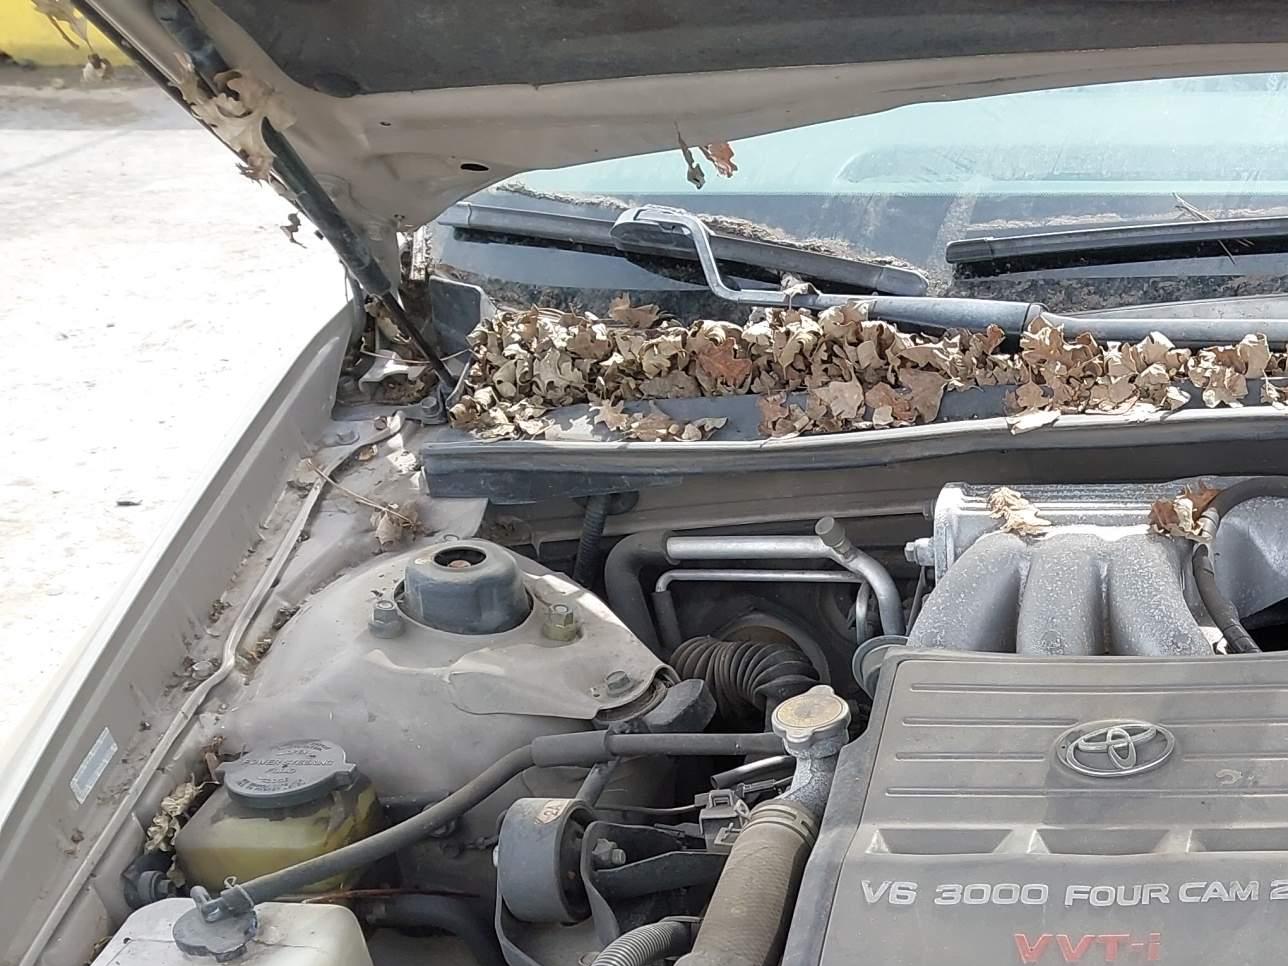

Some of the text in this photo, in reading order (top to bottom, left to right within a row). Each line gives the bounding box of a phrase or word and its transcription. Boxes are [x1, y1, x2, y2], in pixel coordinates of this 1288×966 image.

[861, 879, 918, 905] V6
[934, 883, 1049, 905] 3000
[1064, 882, 1170, 907] FOUR
[1178, 880, 1260, 903] CAM
[1014, 932, 1161, 964] VVT-i
